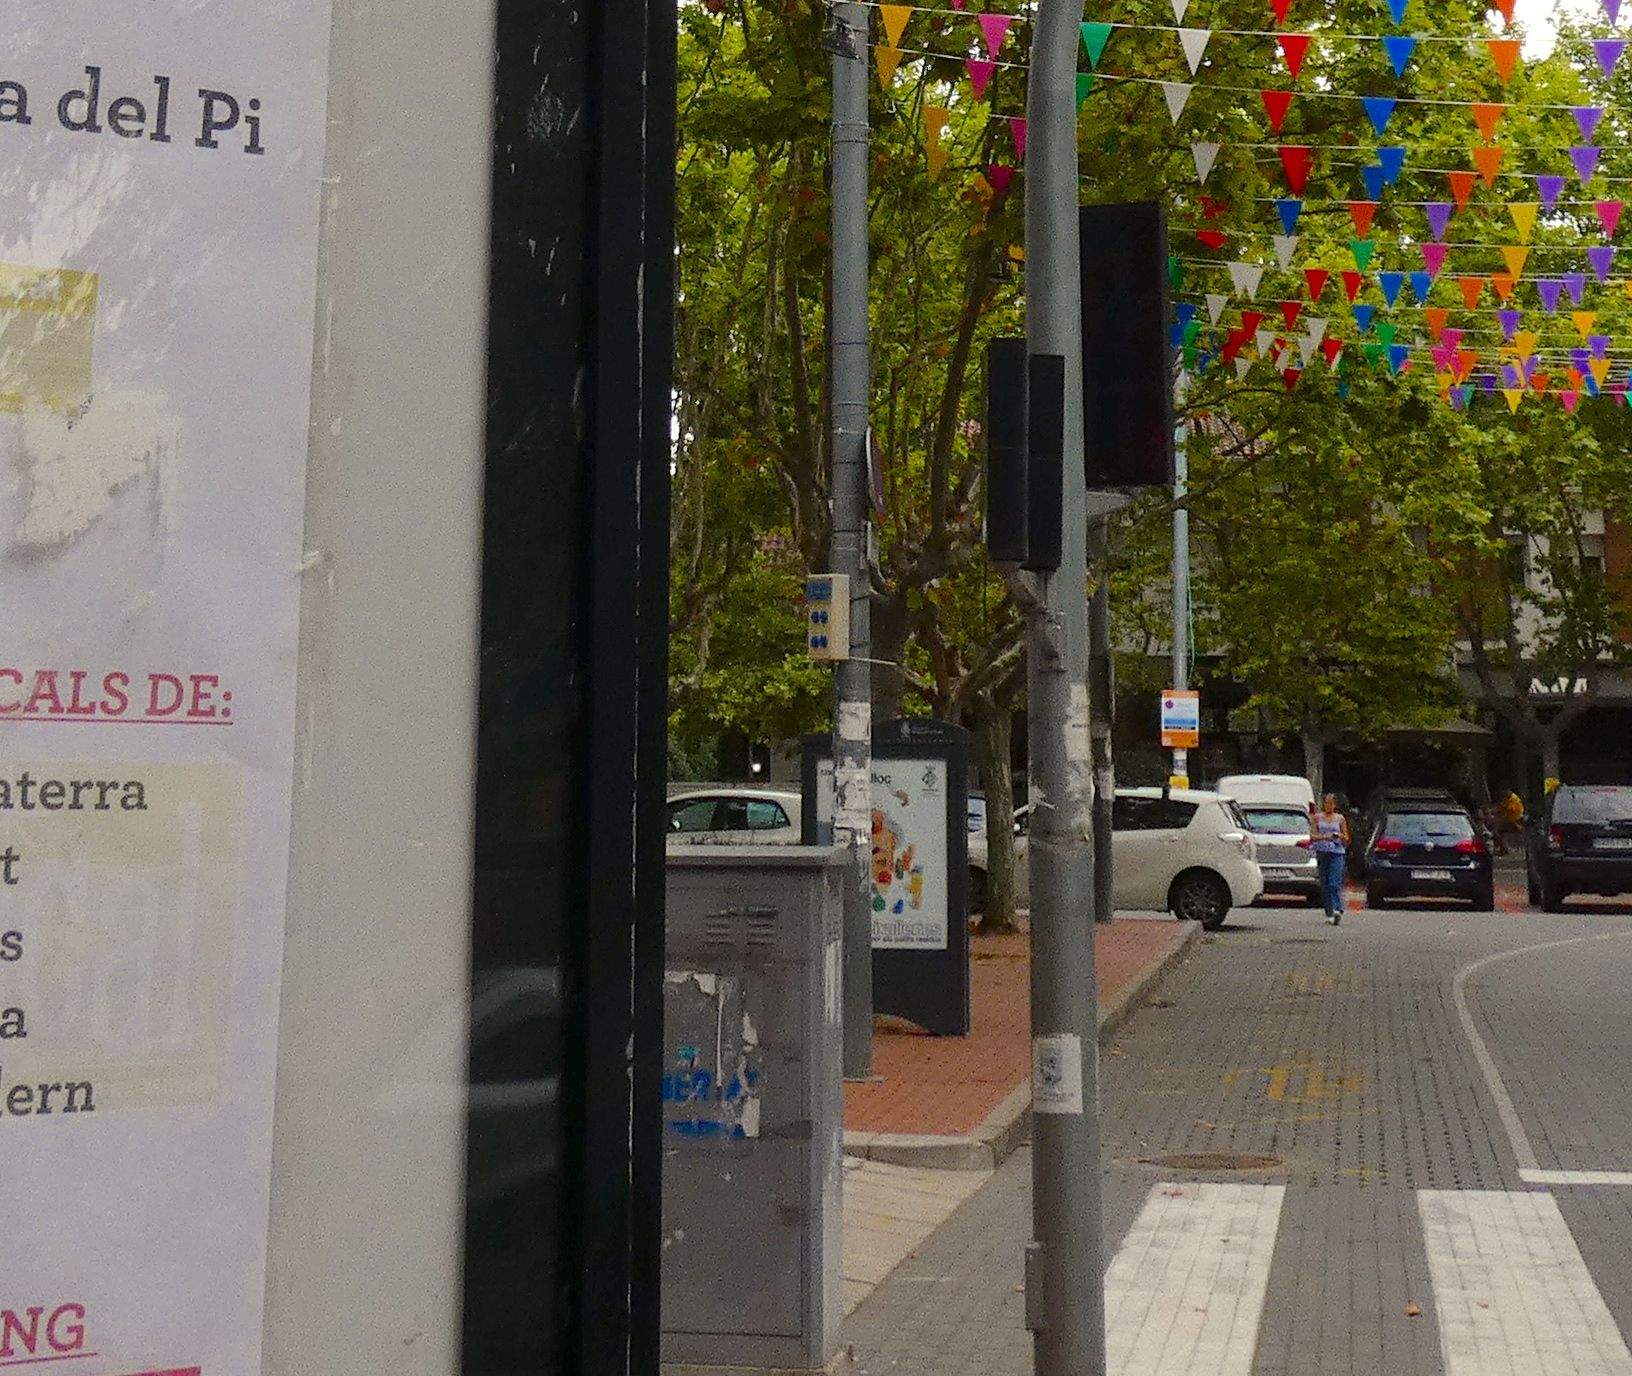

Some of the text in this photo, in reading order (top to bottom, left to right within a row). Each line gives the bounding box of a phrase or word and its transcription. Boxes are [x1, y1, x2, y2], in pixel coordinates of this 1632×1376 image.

[58, 67, 171, 143] del
[195, 89, 267, 157] Pi
[146, 673, 233, 720] DE:
